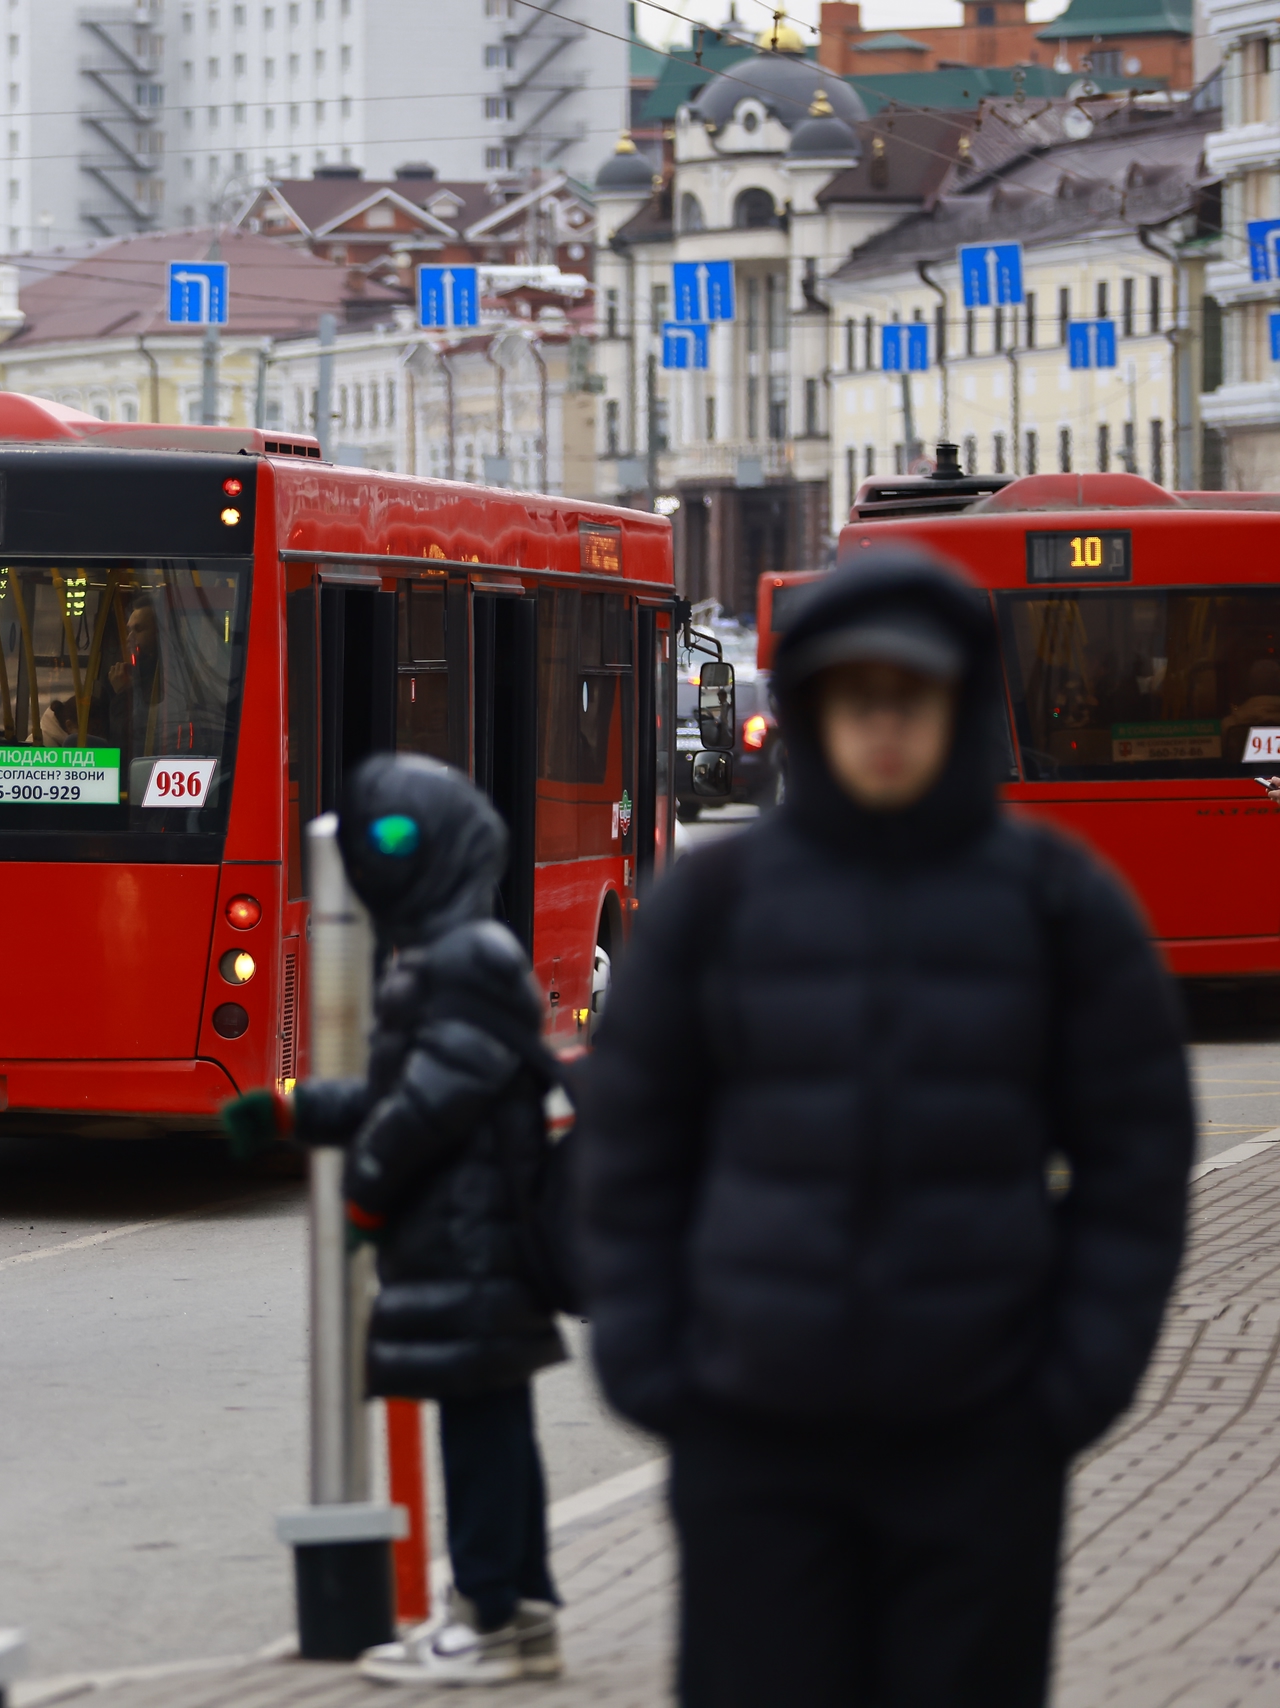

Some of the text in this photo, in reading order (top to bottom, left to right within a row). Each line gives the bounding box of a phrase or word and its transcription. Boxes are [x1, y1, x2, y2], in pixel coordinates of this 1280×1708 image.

[1070, 536, 1102, 567] 10
[62, 751, 95, 767] ПДД
[64, 771, 105, 781] ЗВОНИ
[156, 771, 202, 797] 936
